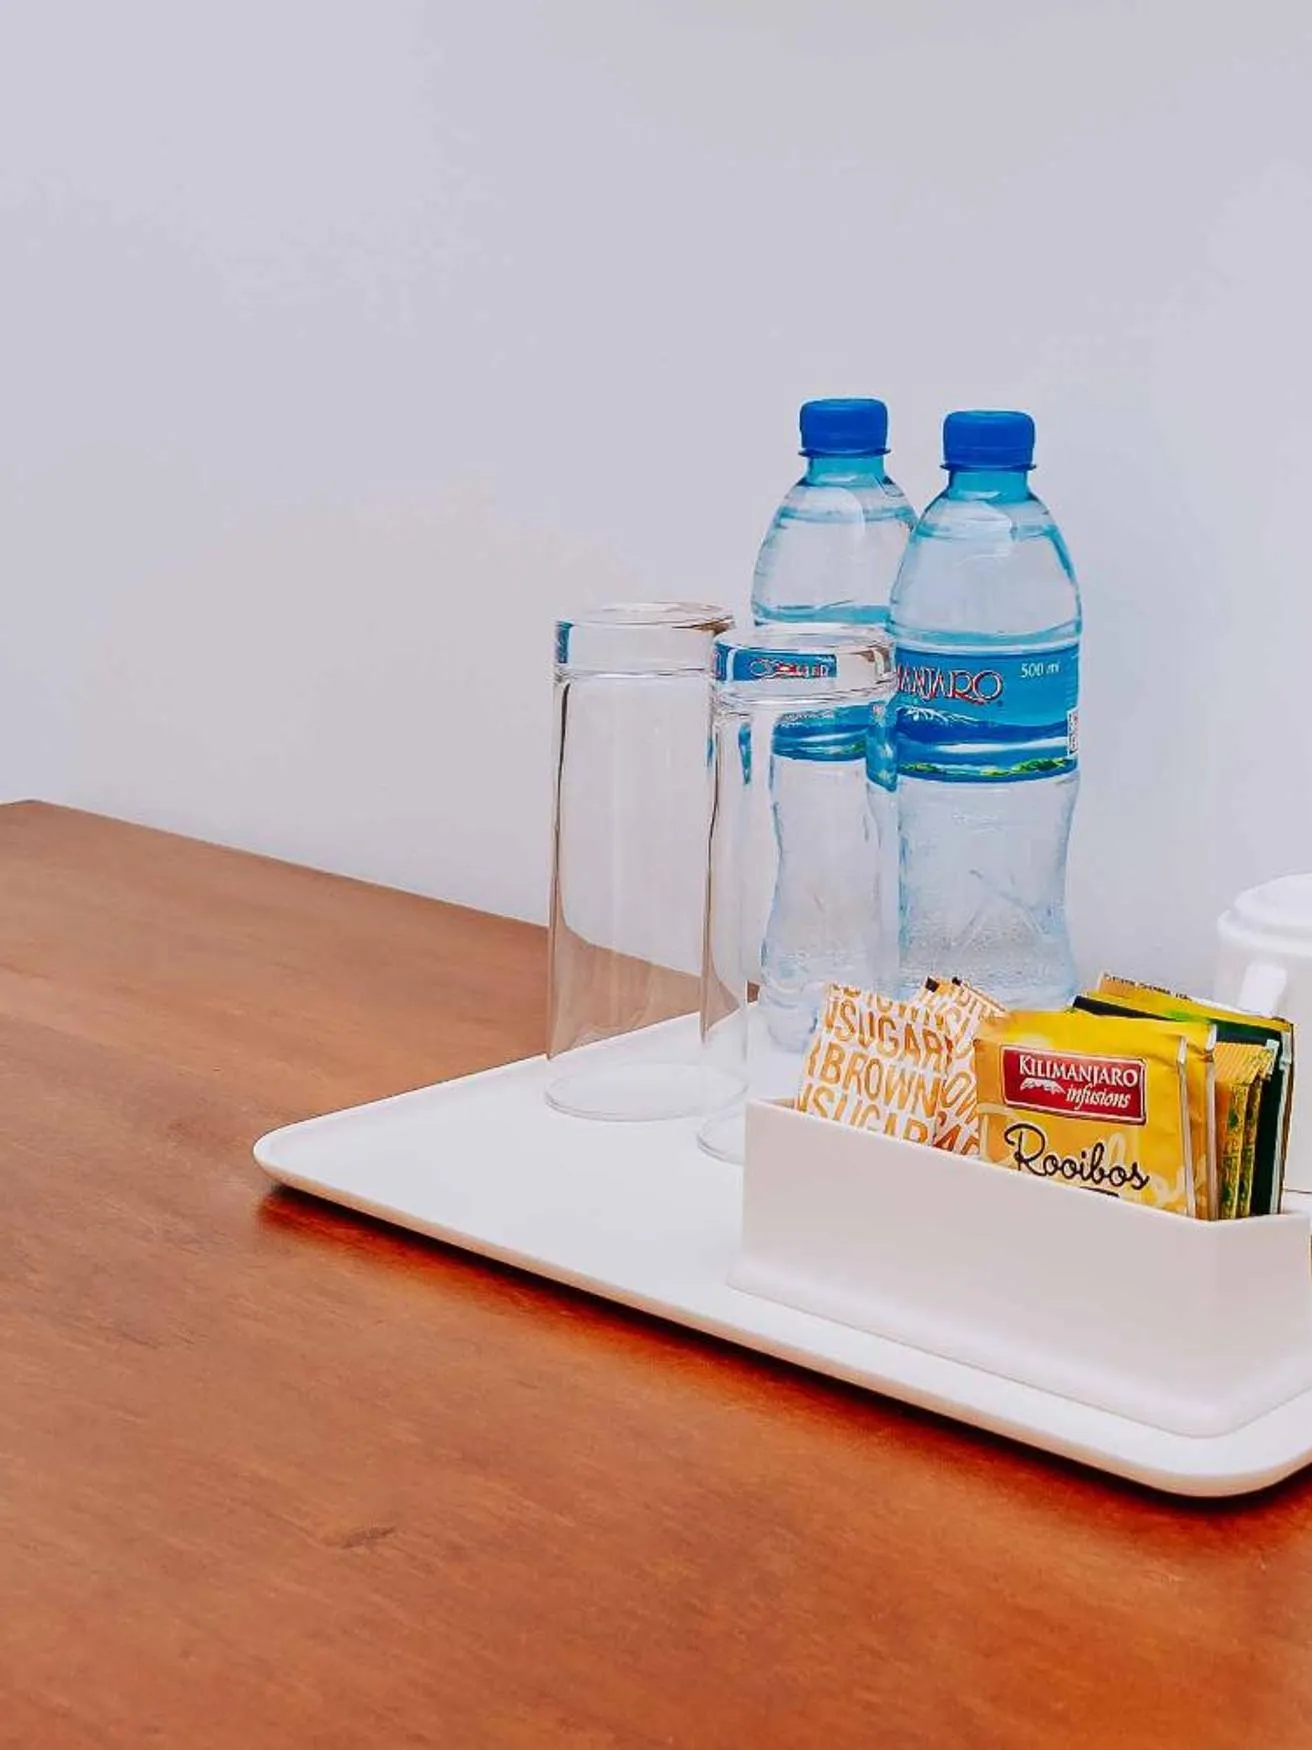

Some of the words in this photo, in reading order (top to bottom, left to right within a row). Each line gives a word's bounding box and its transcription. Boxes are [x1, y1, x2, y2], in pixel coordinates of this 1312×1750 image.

[1020, 662, 1044, 678] 500
[838, 1000, 942, 1074] SUGAR
[819, 1041, 942, 1119] BROWN
[1019, 1054, 1139, 1088] KILIMANJARO
[1066, 1082, 1132, 1111] infusions
[1004, 1122, 1151, 1191] Rooibos
